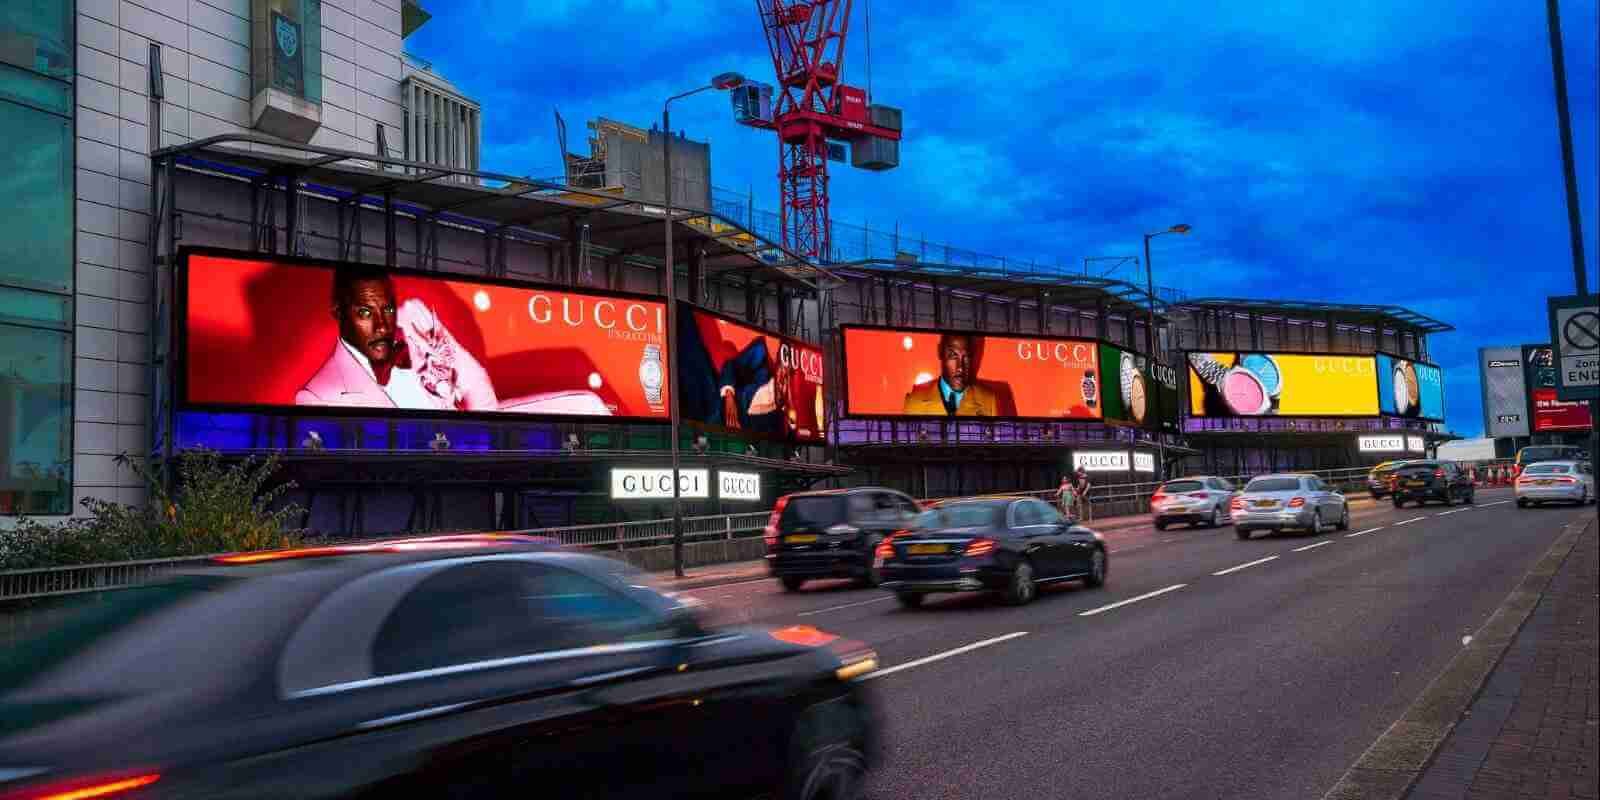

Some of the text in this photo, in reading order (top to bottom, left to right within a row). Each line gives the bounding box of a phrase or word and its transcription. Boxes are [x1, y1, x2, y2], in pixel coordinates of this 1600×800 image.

[528, 294, 662, 333] GUCCI
[780, 343, 823, 377] GUCCI
[1017, 343, 1097, 362] GUCCI
[1151, 363, 1176, 385] GUCCI
[1313, 358, 1375, 374] GUCCI
[1364, 439, 1400, 448] GUCCI
[1080, 455, 1124, 465] GUCCI
[623, 475, 699, 493] GUCCI
[723, 476, 756, 494] GUCCI
